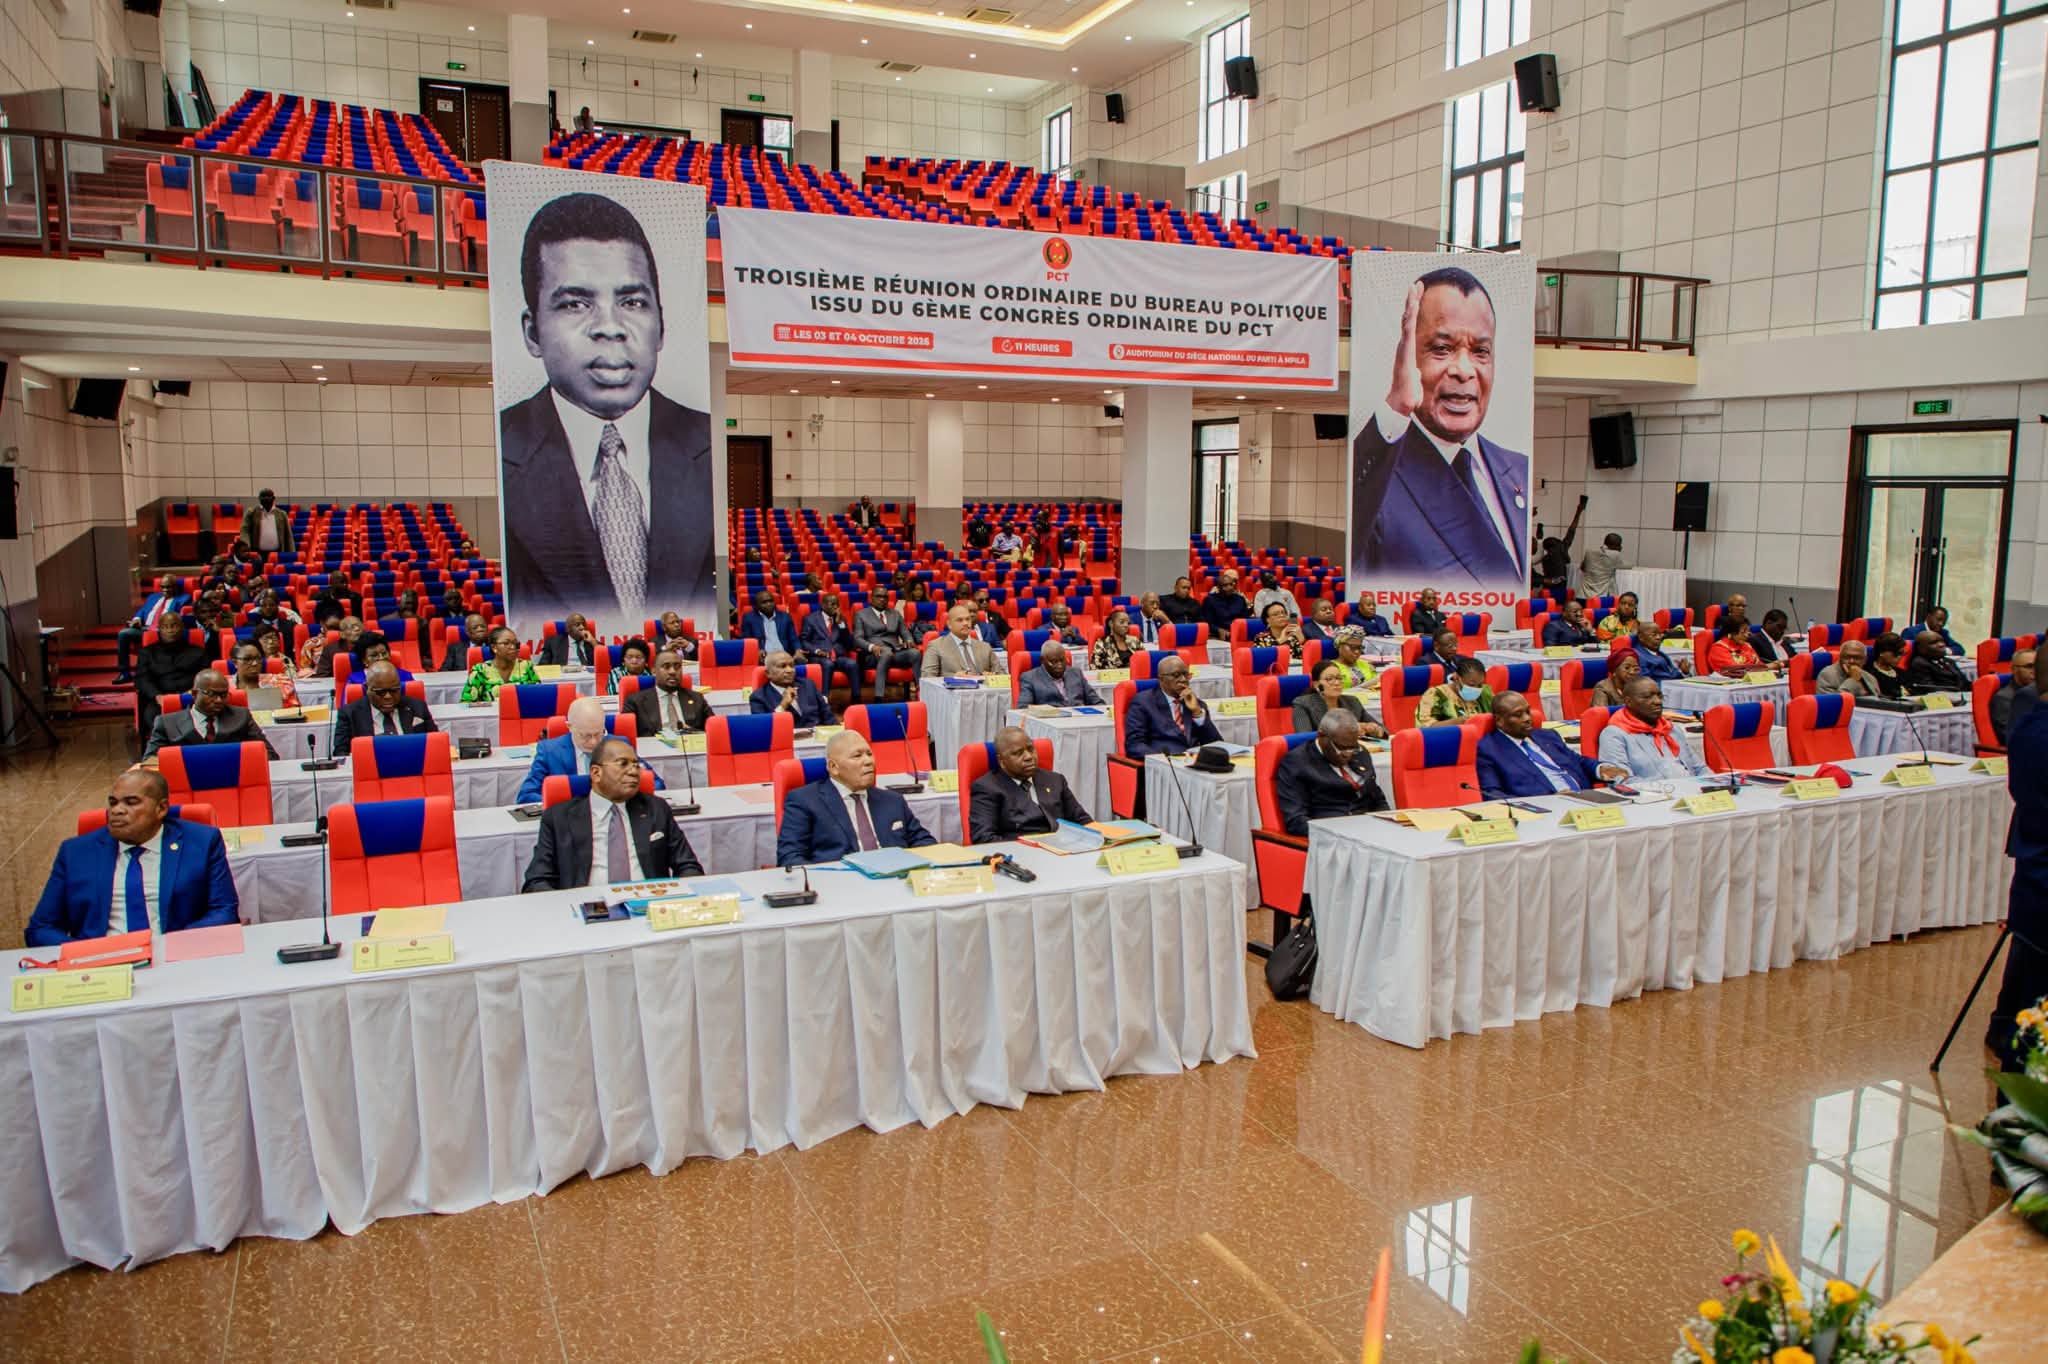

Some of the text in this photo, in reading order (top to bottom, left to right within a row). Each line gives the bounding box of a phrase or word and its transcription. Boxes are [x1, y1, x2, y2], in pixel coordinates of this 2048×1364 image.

[1046, 271, 1070, 282] PCT
[734, 266, 1328, 322] TROISIÈME RÉUNION ORDINAIRE DU BUREAU POLITIQUE
[810, 295, 1274, 337] ISSU DU 6ÈME CONGRÈS ORDINAIRE DU PCT
[793, 329, 812, 339] LES
[814, 331, 827, 340] 03
[829, 332, 842, 341] ET
[859, 333, 905, 345] OCTOBRE
[1024, 343, 1060, 353] HEURES
[1126, 348, 1173, 359] AUDITORIUM
[1174, 351, 1185, 360] DU
[1186, 351, 1207, 361] SIÈGE
[1208, 353, 1245, 362] NATIONAL
[1257, 355, 1277, 364] PARTI
[1918, 402, 1944, 413] SORTIE
